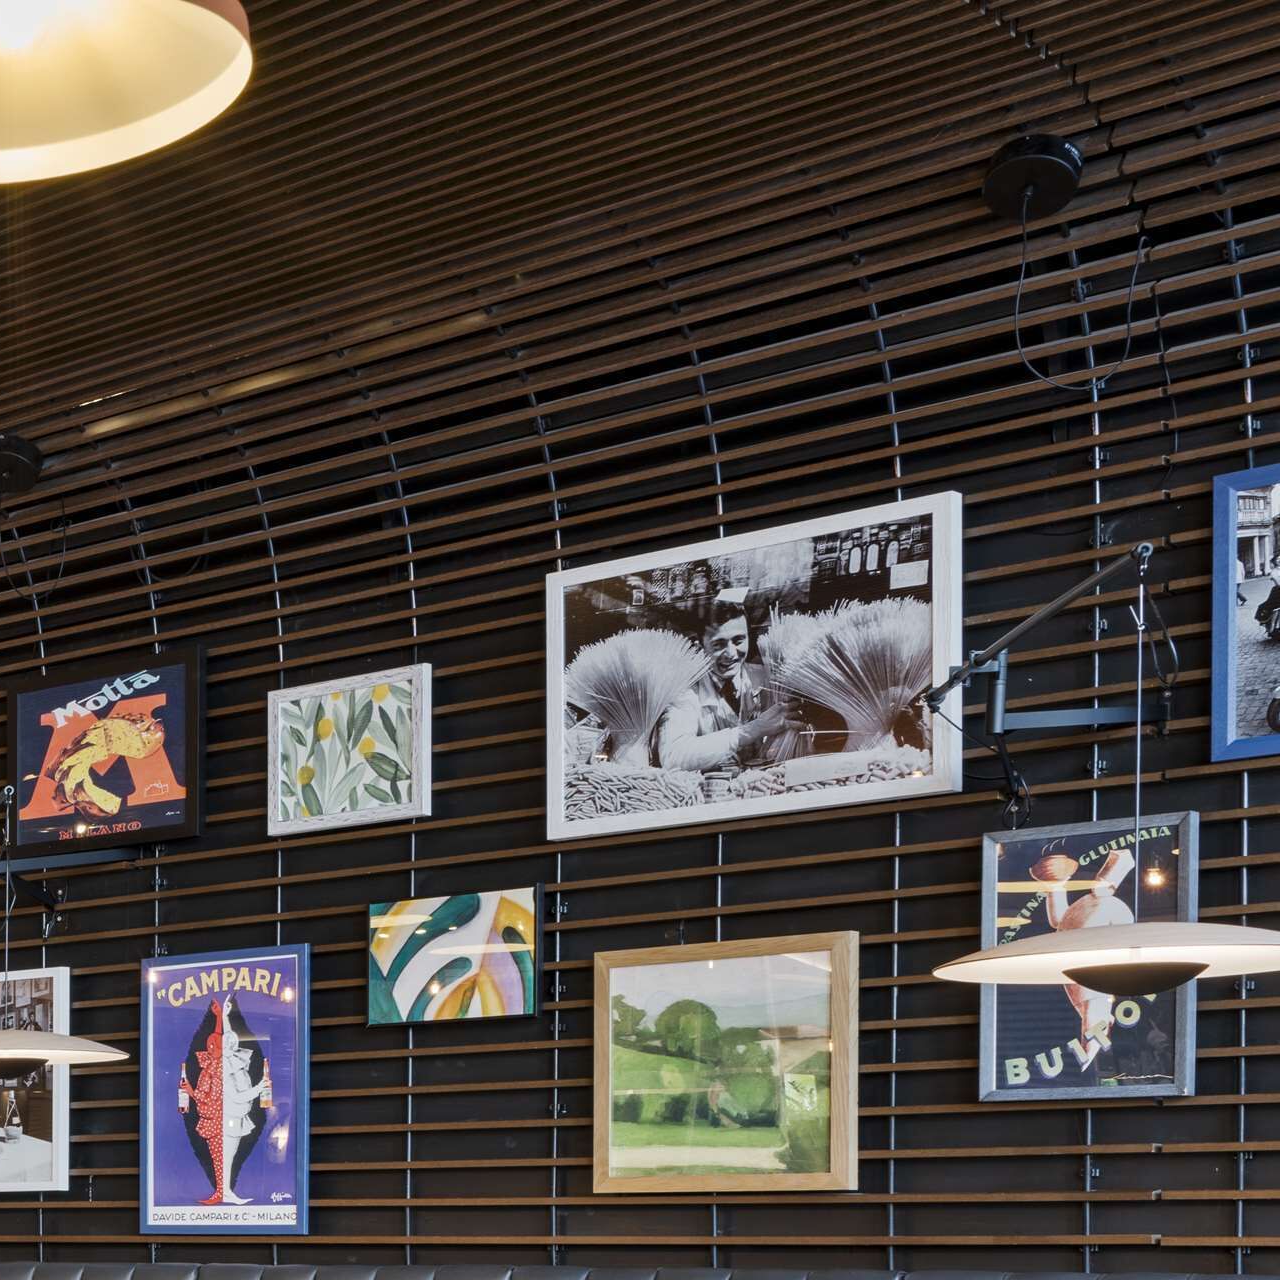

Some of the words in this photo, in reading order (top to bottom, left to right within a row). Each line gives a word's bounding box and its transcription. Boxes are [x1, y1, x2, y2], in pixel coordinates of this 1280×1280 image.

[52, 670, 160, 728] Motta
[1078, 826, 1171, 866] GLUTINATA
[999, 891, 1047, 944] PASINA
[1005, 994, 1157, 1085] BUITO
[152, 1213, 187, 1222] DAVIDE
[190, 1212, 233, 1222] CAMPARI
